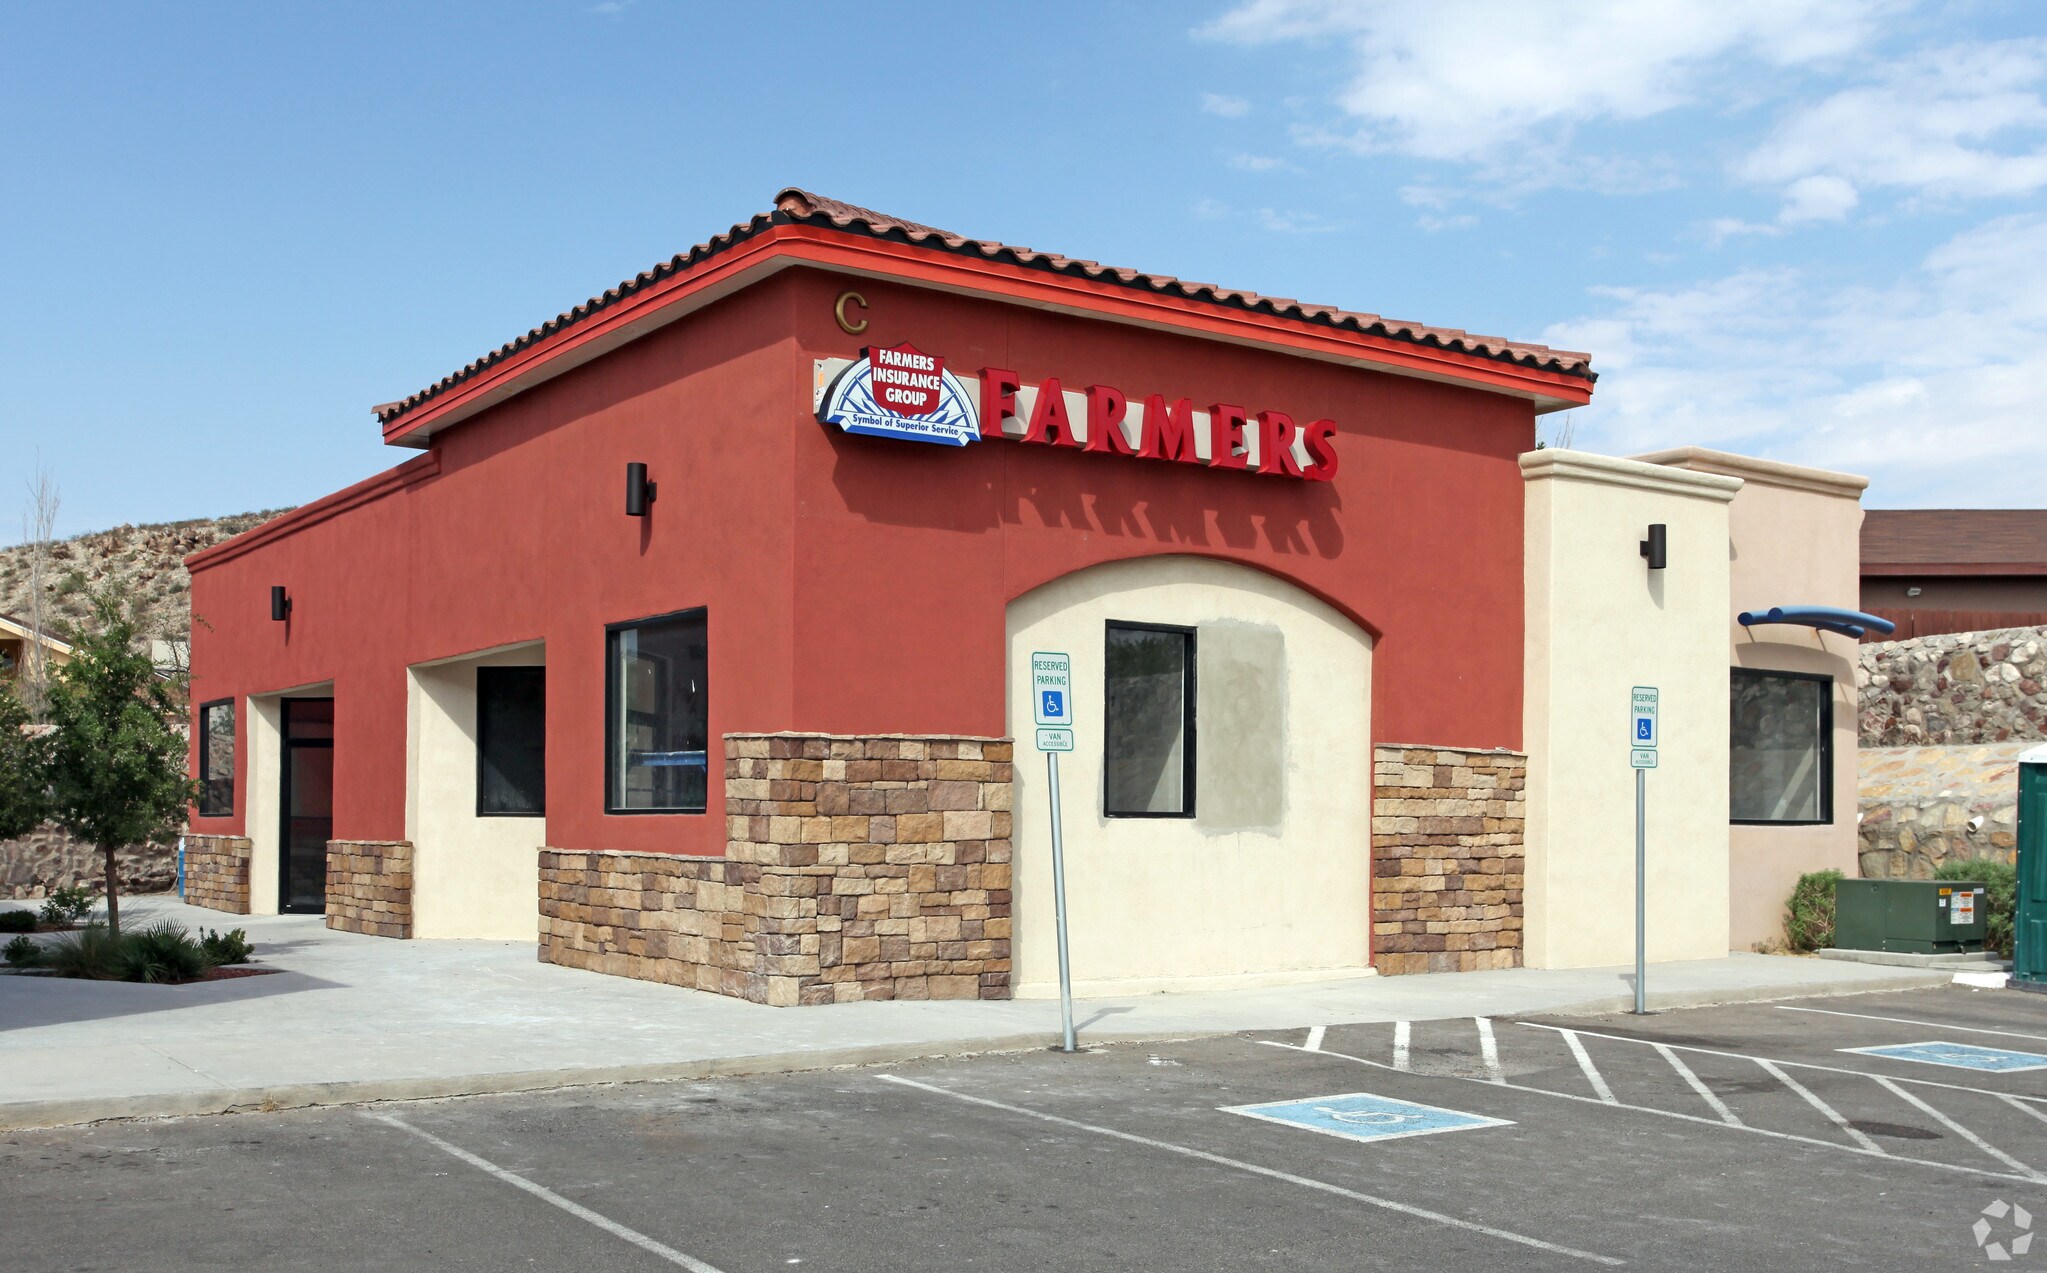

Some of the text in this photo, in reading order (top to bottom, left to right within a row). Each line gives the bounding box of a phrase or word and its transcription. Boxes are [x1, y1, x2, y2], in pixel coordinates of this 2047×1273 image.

[834, 291, 869, 336] C
[879, 349, 935, 371] FARMERS
[873, 367, 940, 390] INSURANCE
[885, 387, 928, 406] GROUP
[852, 413, 959, 436] Symbol of Superior Service
[977, 366, 1338, 481] FARMERS
[1034, 660, 1068, 671] RESERVED
[1036, 675, 1066, 686] PARKING
[1633, 693, 1657, 703] RESERVED
[1634, 705, 1655, 714] PARKING
